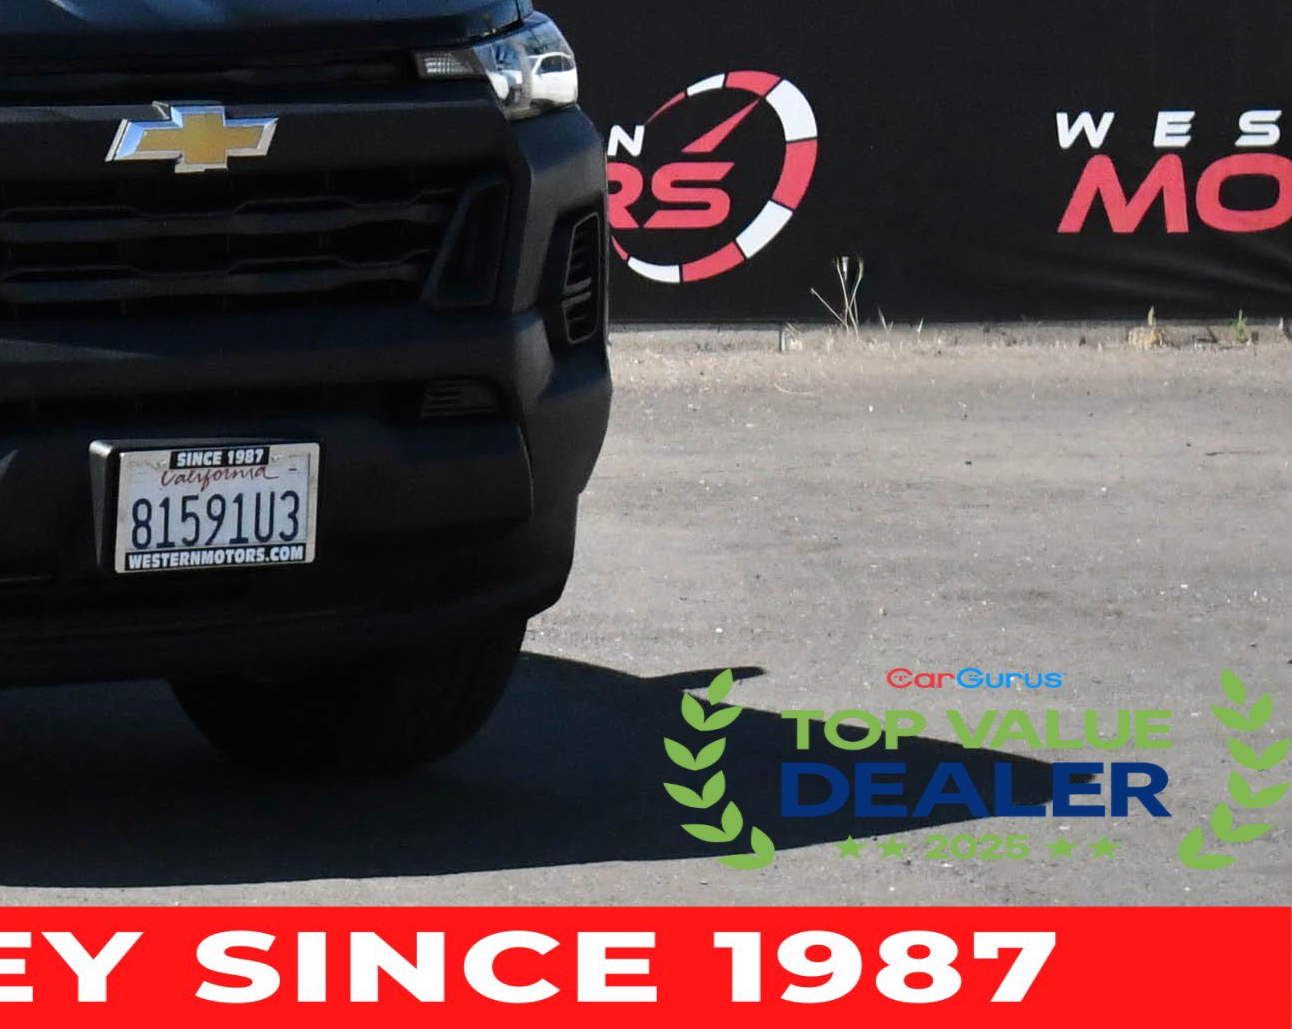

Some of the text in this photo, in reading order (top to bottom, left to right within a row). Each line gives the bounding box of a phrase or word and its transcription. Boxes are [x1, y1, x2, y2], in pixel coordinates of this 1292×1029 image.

[176, 448, 264, 468] SINCE 1987
[160, 466, 280, 492] California
[131, 490, 301, 550] 81591U3
[127, 545, 305, 570] WESTERNMOTORS.COM
